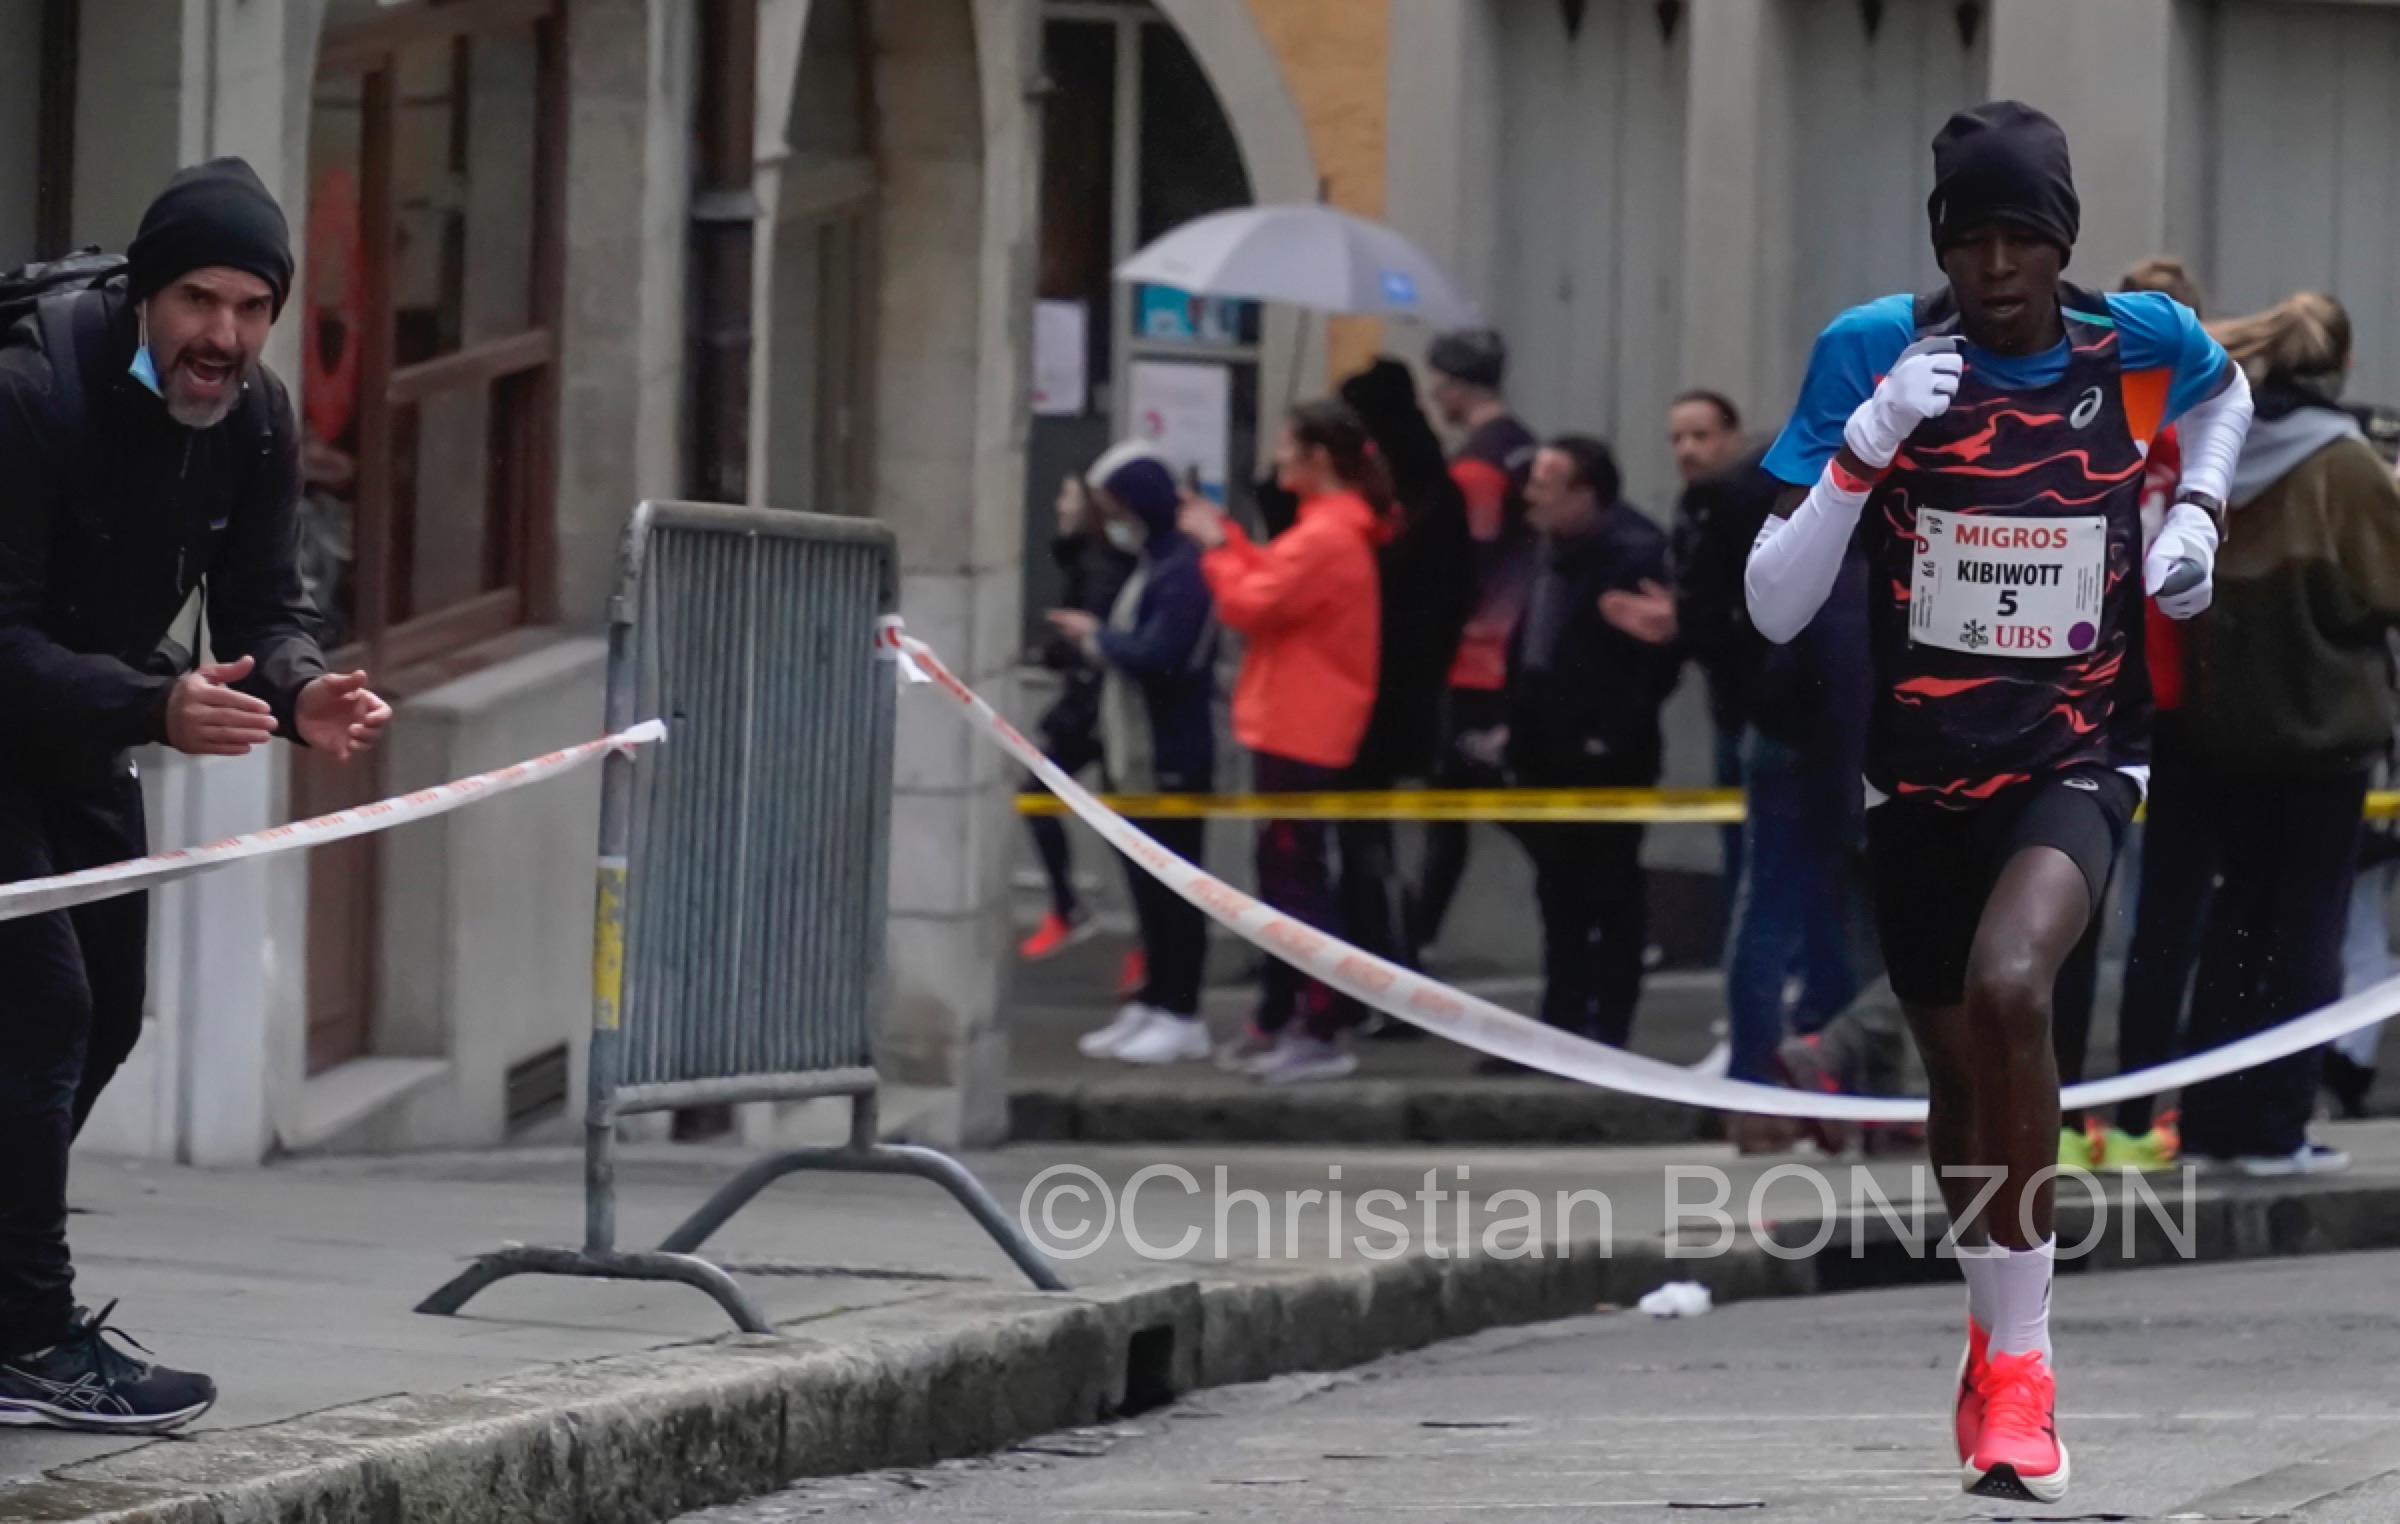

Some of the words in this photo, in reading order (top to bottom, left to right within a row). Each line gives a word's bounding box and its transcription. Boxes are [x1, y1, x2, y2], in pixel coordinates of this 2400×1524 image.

[1955, 523, 2068, 549] MIGROS
[1957, 559, 2063, 587] KIBIWOTT
[1996, 589, 2018, 617] 5
[1995, 624, 2053, 650] UBS
